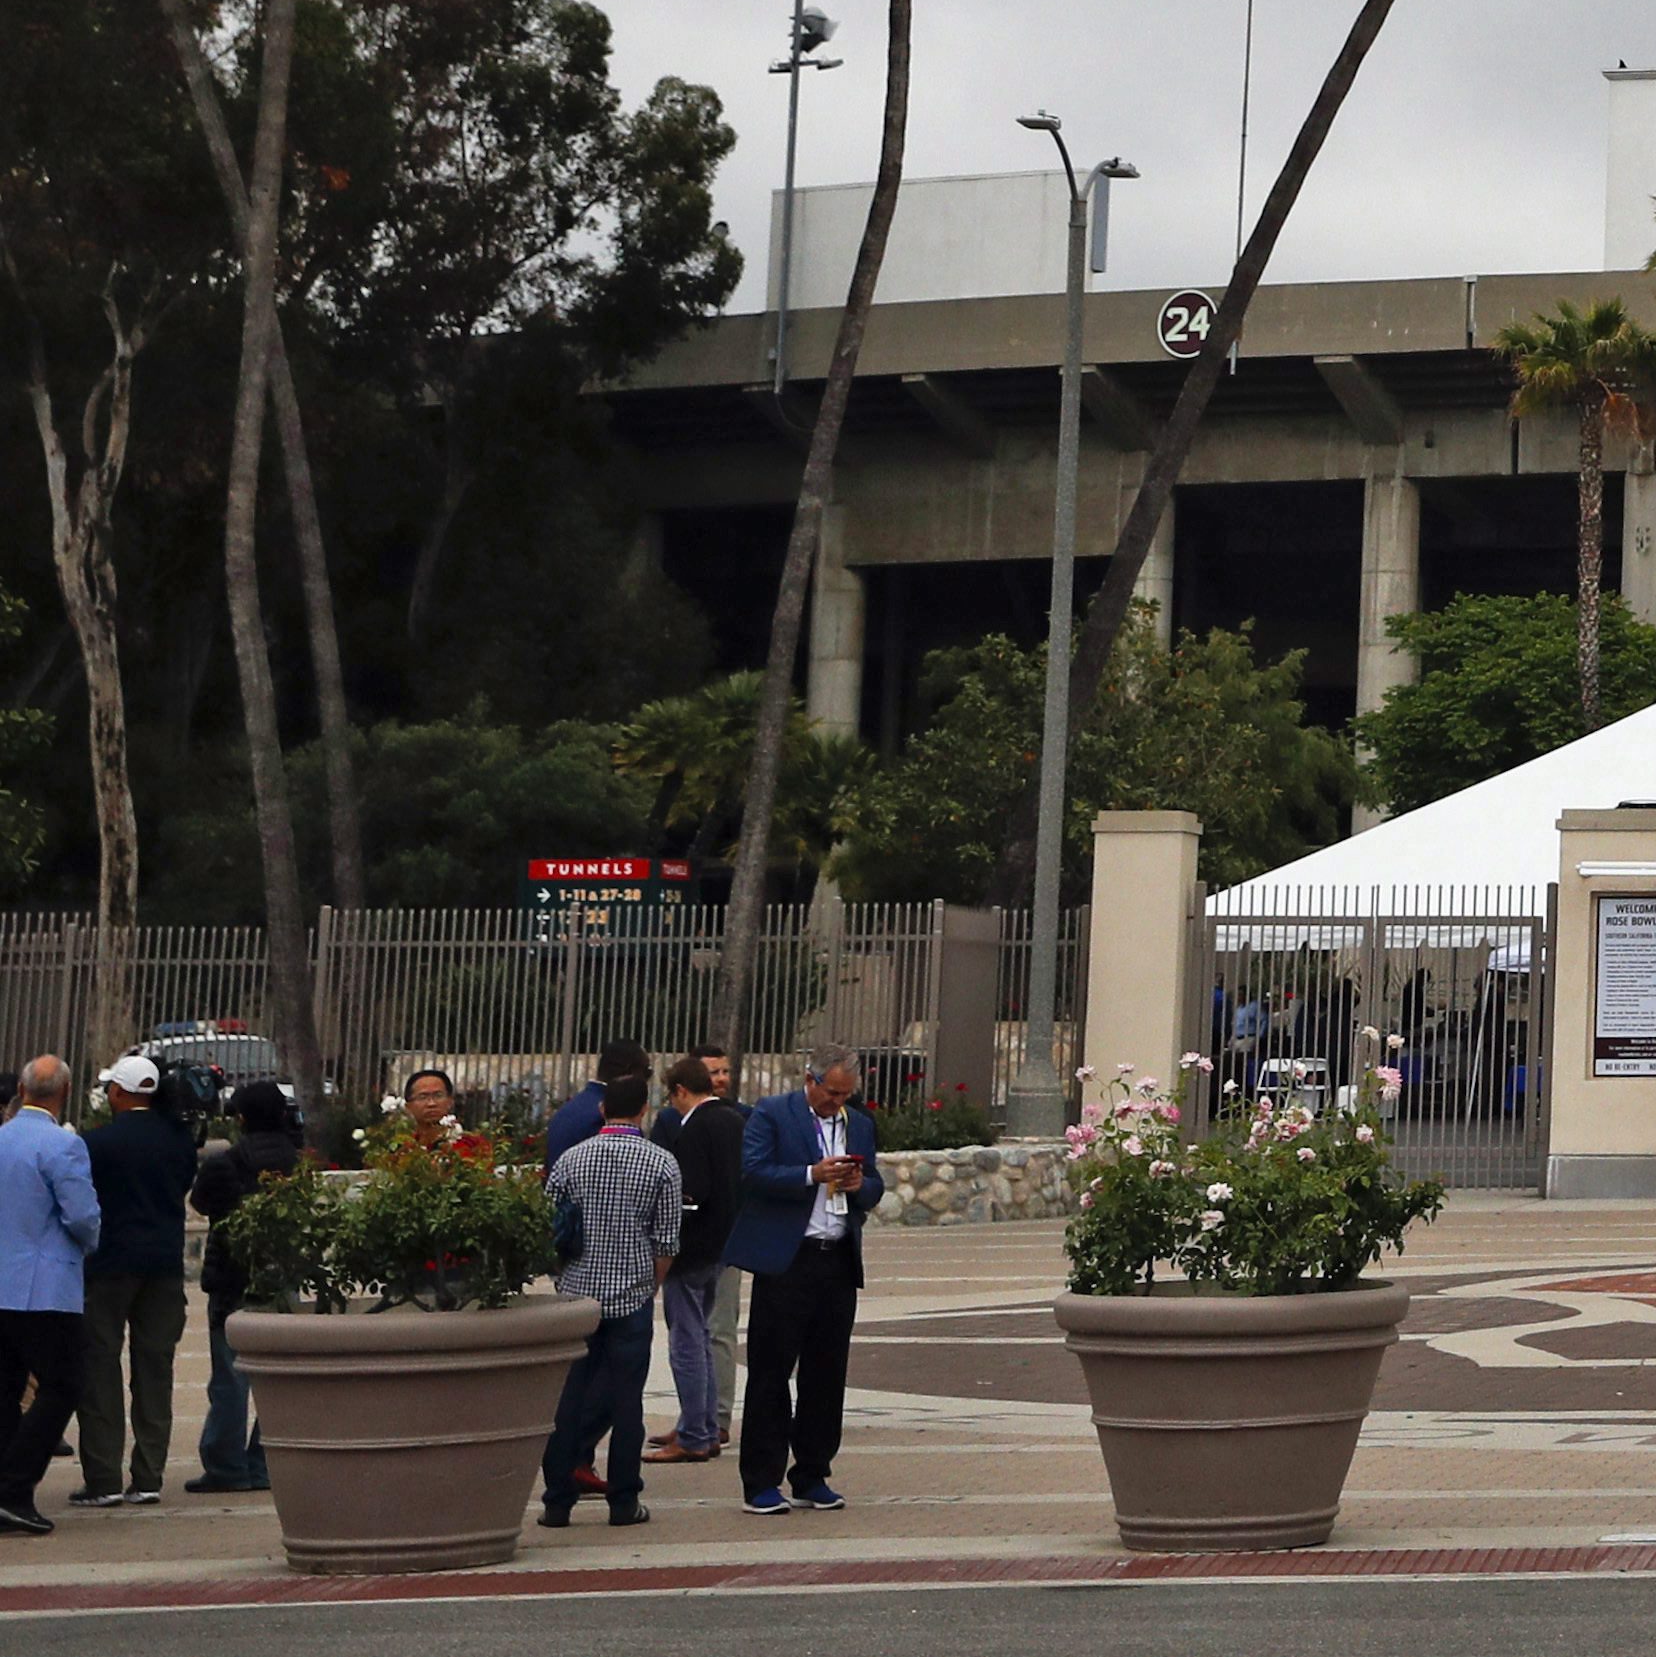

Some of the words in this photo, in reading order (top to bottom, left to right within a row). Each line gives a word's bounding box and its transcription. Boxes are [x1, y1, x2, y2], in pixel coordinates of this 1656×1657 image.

[1165, 305, 1211, 342] 24
[546, 862, 633, 875] TUNNELS
[1605, 916, 1629, 927] ROSE
[1631, 916, 1656, 927] BOWL
